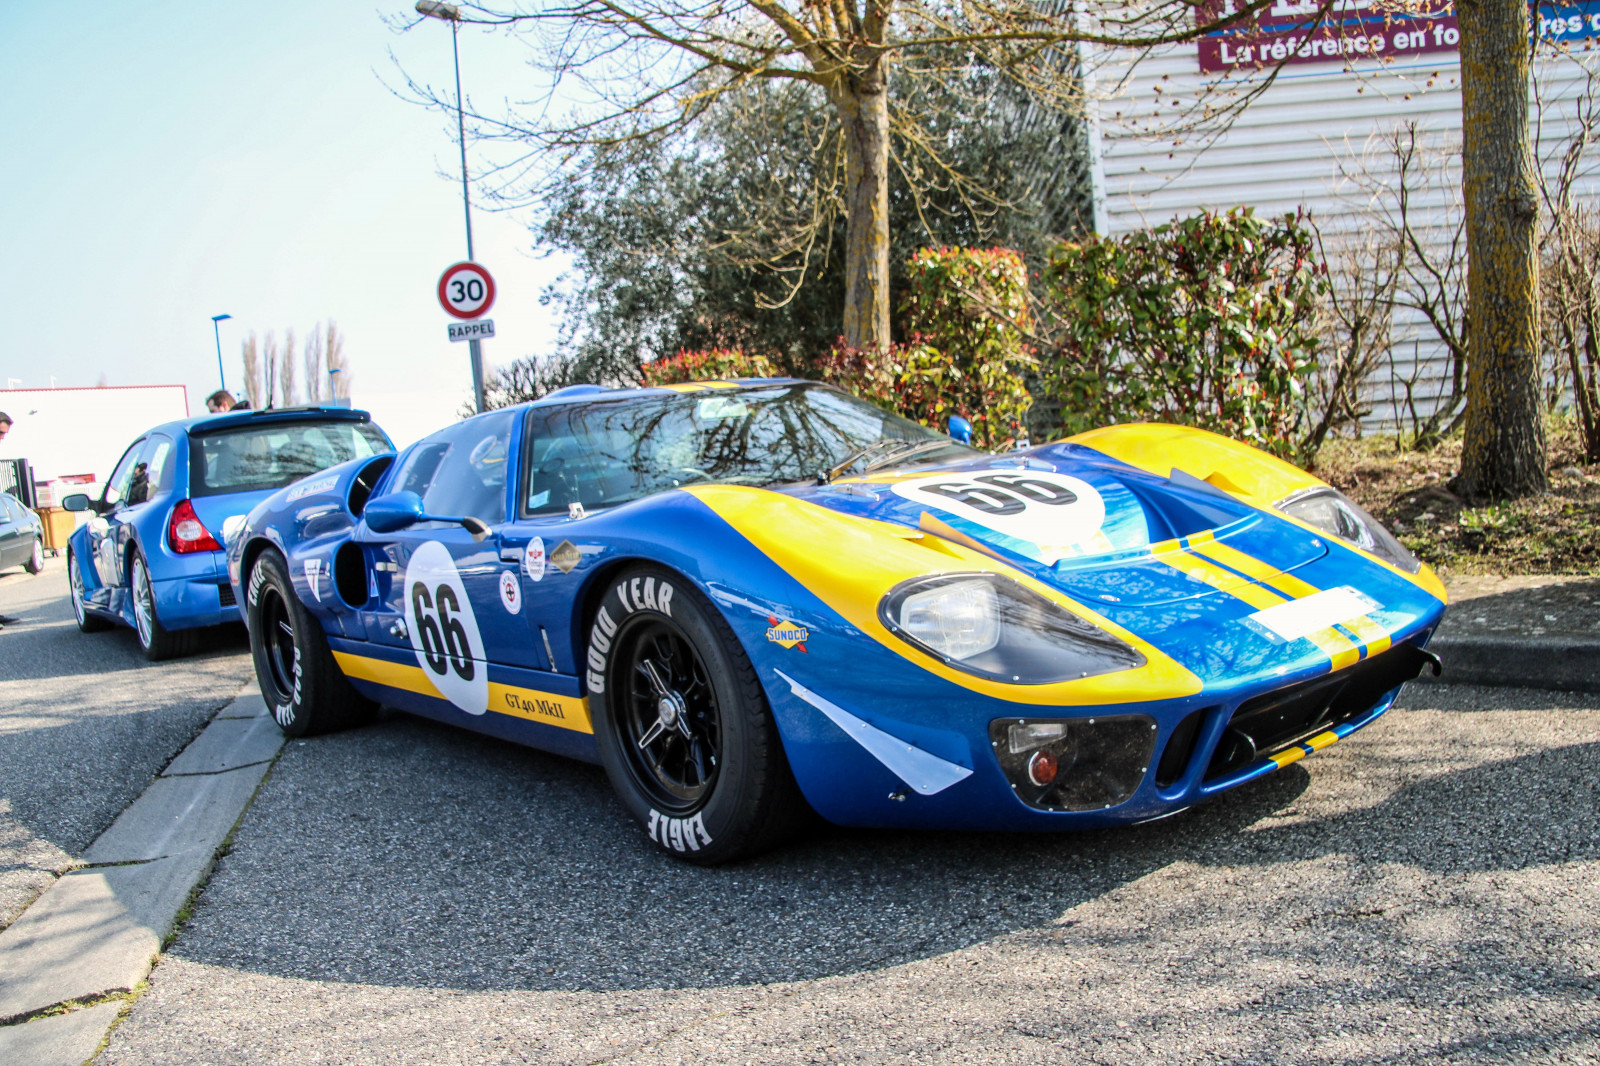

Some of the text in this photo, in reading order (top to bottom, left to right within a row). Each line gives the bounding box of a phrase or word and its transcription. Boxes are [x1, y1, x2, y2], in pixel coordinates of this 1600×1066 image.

[1220, 42, 1252, 64] La
[1260, 34, 1386, 60] référence
[1393, 31, 1425, 49] en
[1433, 24, 1459, 46] fo
[451, 279, 483, 303] 30
[449, 323, 494, 338] RAPPEL
[918, 474, 1077, 516] 66
[412, 581, 475, 682] 66
[586, 576, 674, 694] GOOD YEAR
[768, 628, 807, 641] SUNOCO
[505, 693, 565, 719] GT40 MkII
[648, 809, 712, 852] EAGLE
